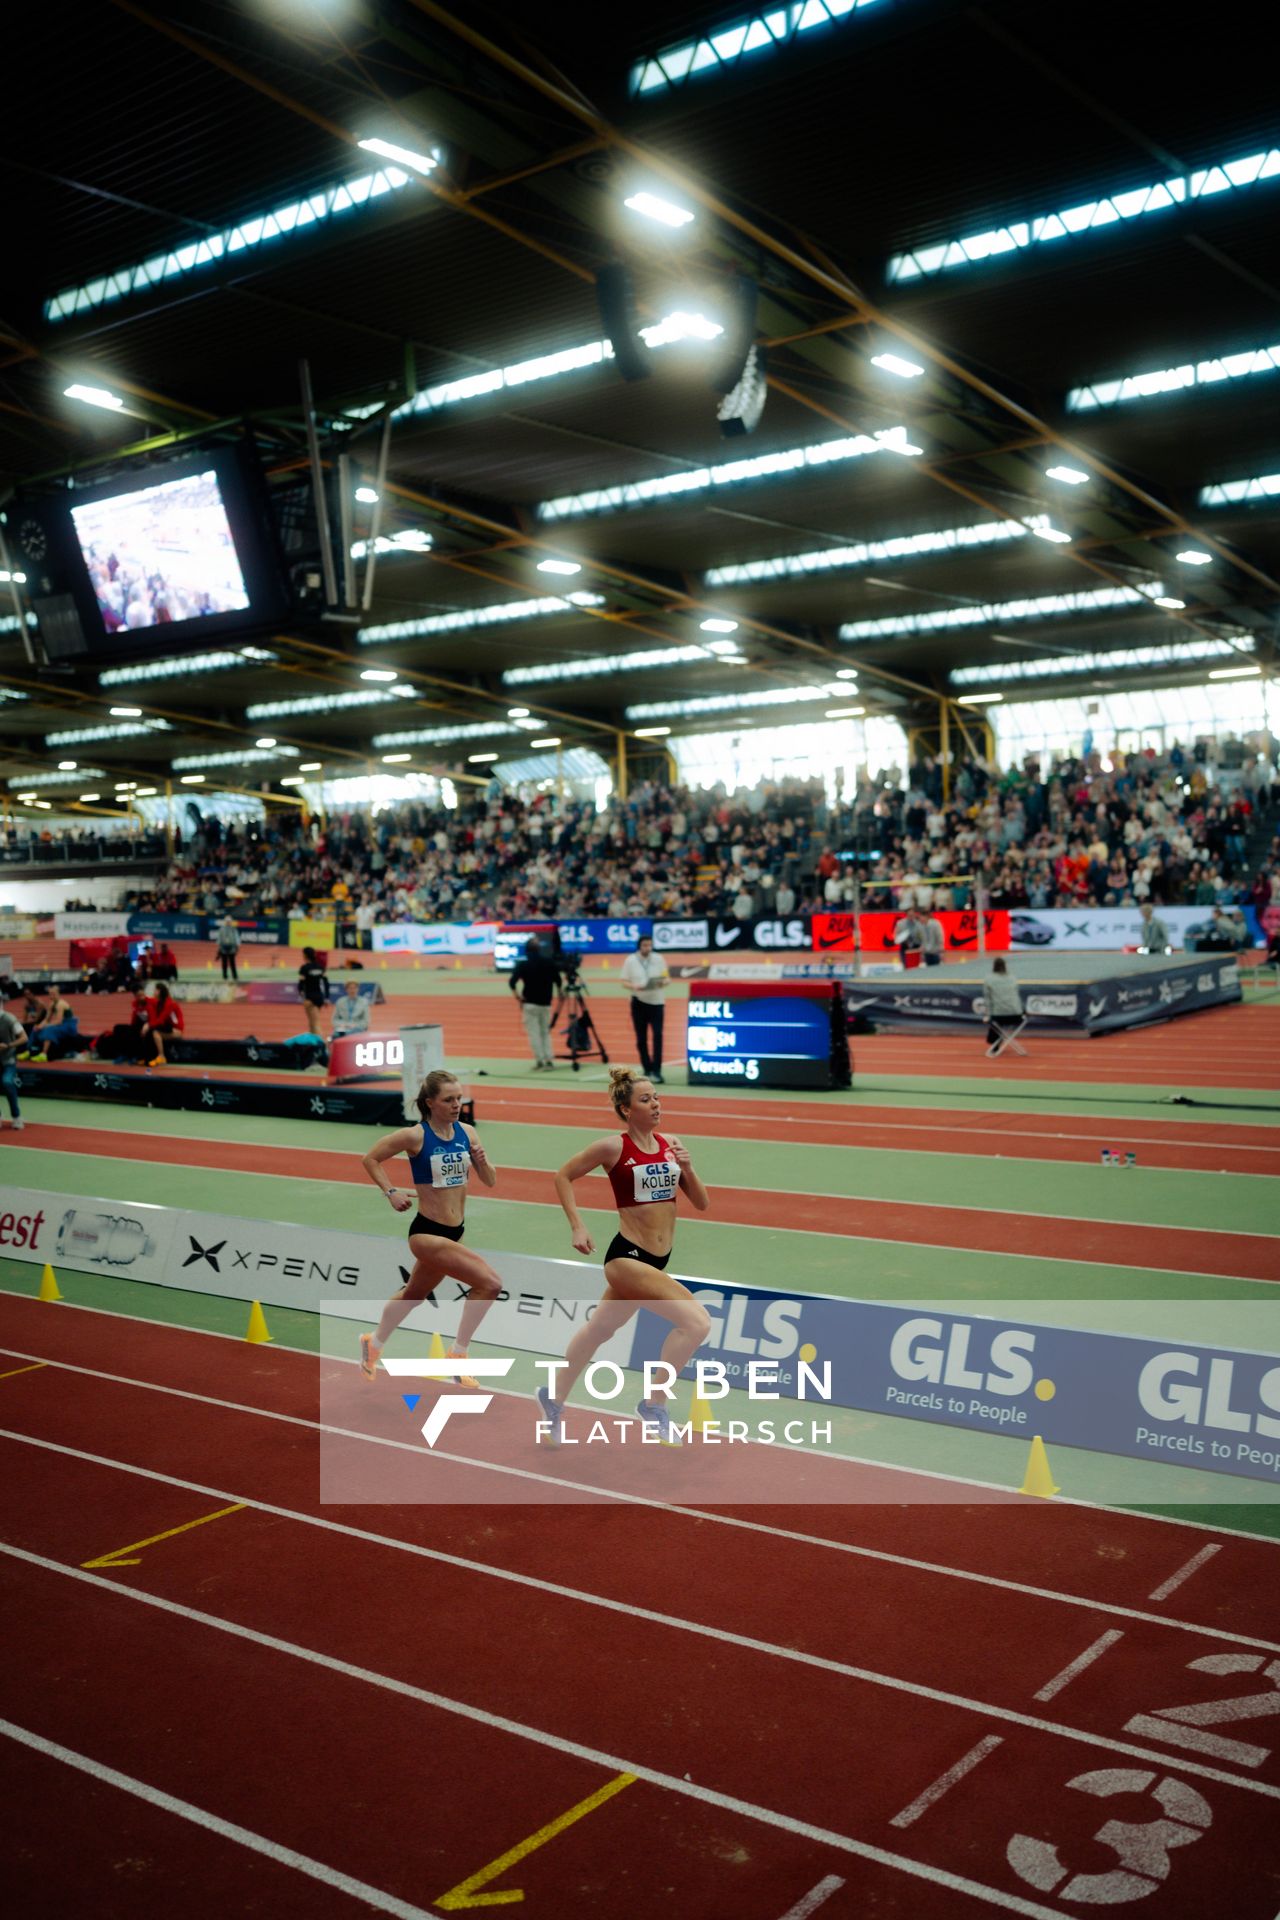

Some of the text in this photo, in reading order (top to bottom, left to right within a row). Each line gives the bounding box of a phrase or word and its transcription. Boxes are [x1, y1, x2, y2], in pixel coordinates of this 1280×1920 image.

[723, 1002, 735, 1019] L
[689, 1056, 760, 1080] Versuch 5
[442, 1153, 463, 1164] GLS
[645, 1163, 670, 1176] GLS
[641, 1174, 677, 1189] KOLBE
[232, 1249, 360, 1286] XPENG
[886, 1386, 1028, 1425] Parcels to People
[1136, 1426, 1205, 1454] Parcels
[1211, 1440, 1232, 1458] to
[1006, 1768, 1213, 1904] 3
